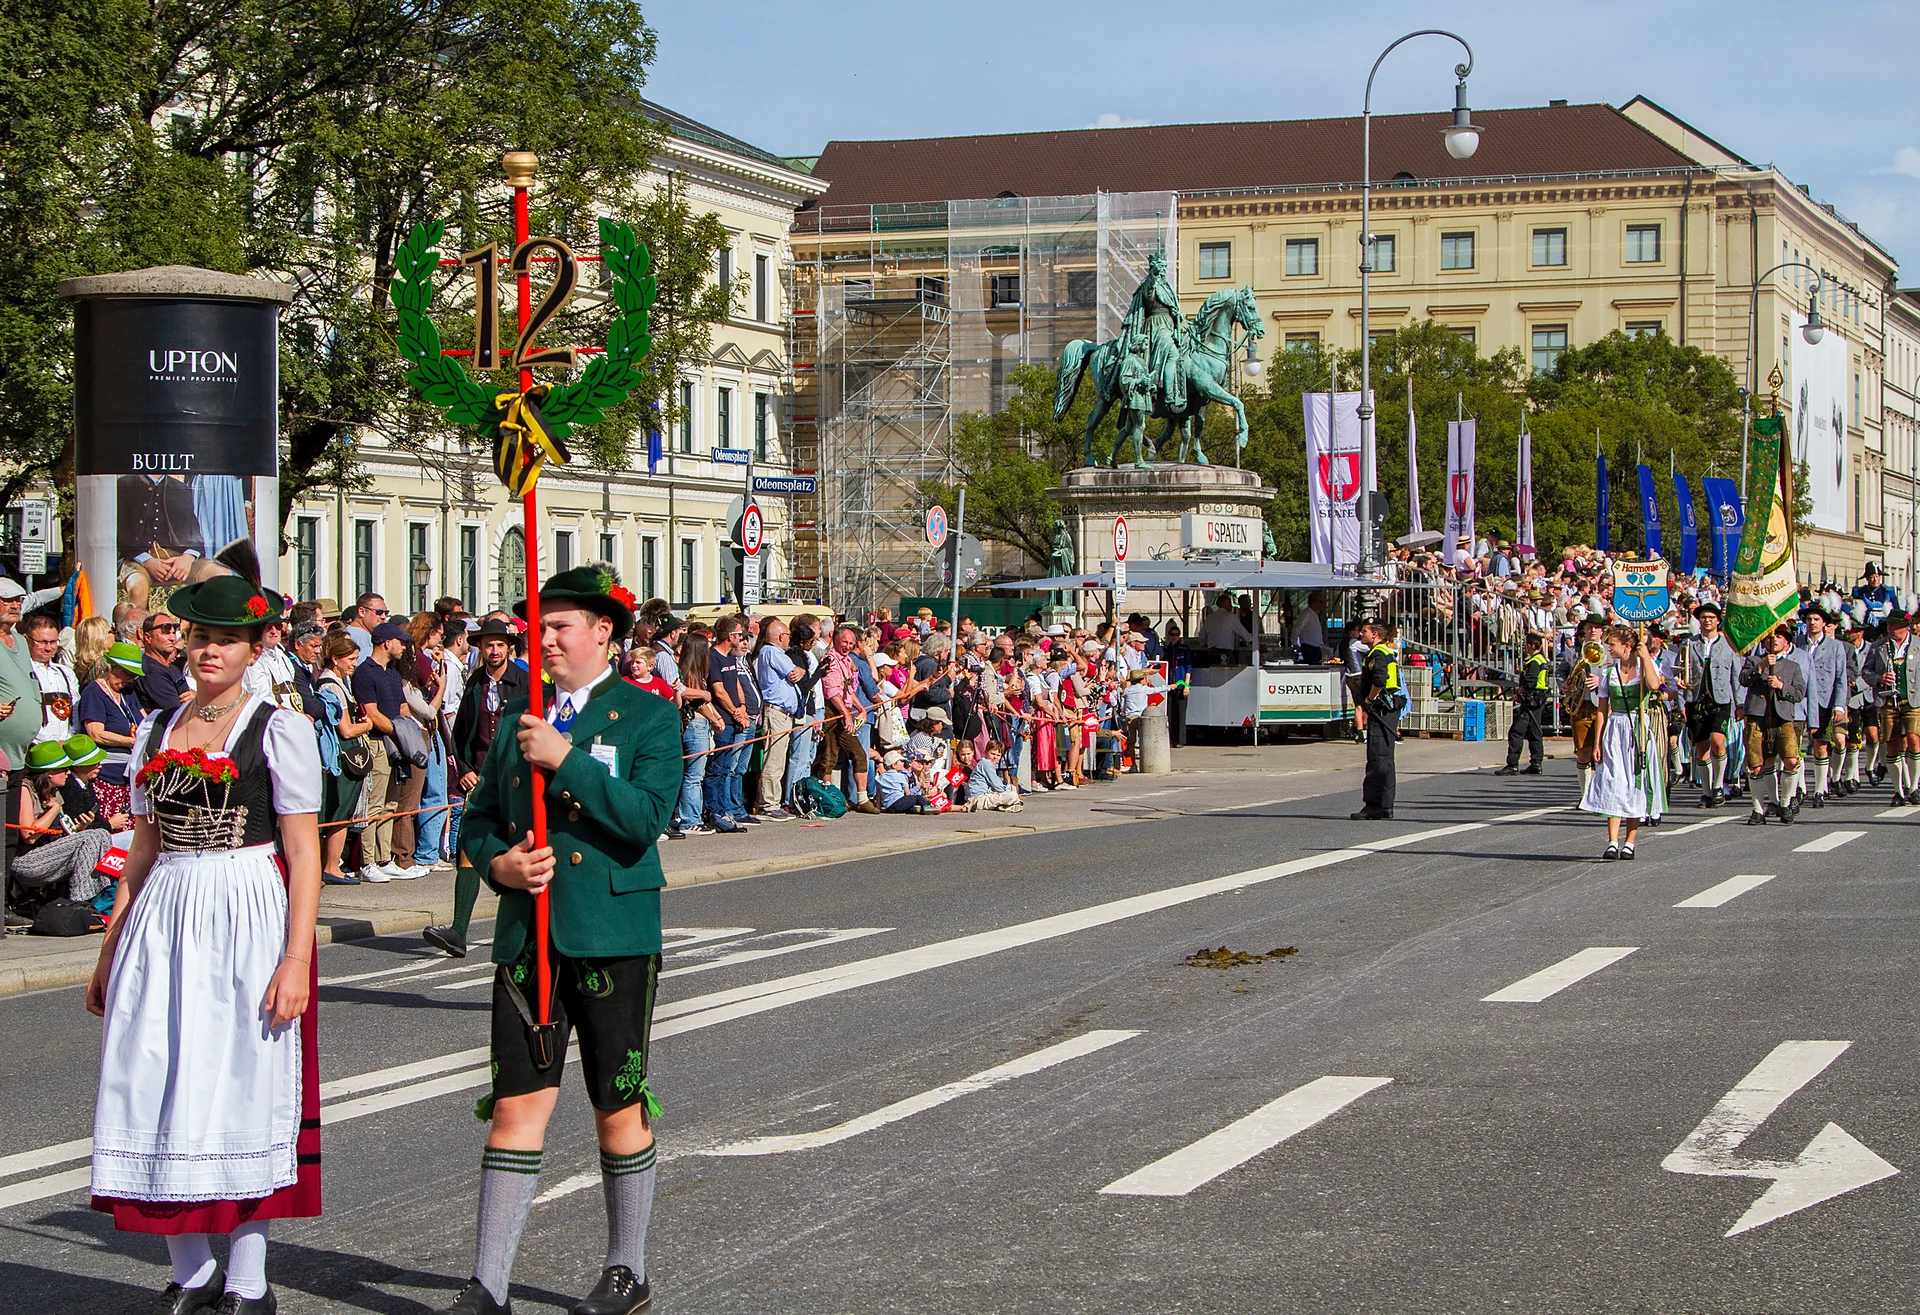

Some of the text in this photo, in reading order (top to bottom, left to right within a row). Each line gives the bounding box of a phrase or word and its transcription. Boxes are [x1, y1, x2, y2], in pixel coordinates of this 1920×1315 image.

[462, 237, 578, 370] 12
[149, 349, 237, 374] UPTON
[132, 453, 195, 471] BUILT
[715, 449, 748, 464] Odeonsplatz
[755, 478, 812, 492] Odeonsplatz
[1214, 522, 1247, 543] SPATEN
[1622, 563, 1659, 572] Harmonie
[1618, 604, 1665, 618] Neubiberg
[1278, 684, 1322, 695] SPATEN
